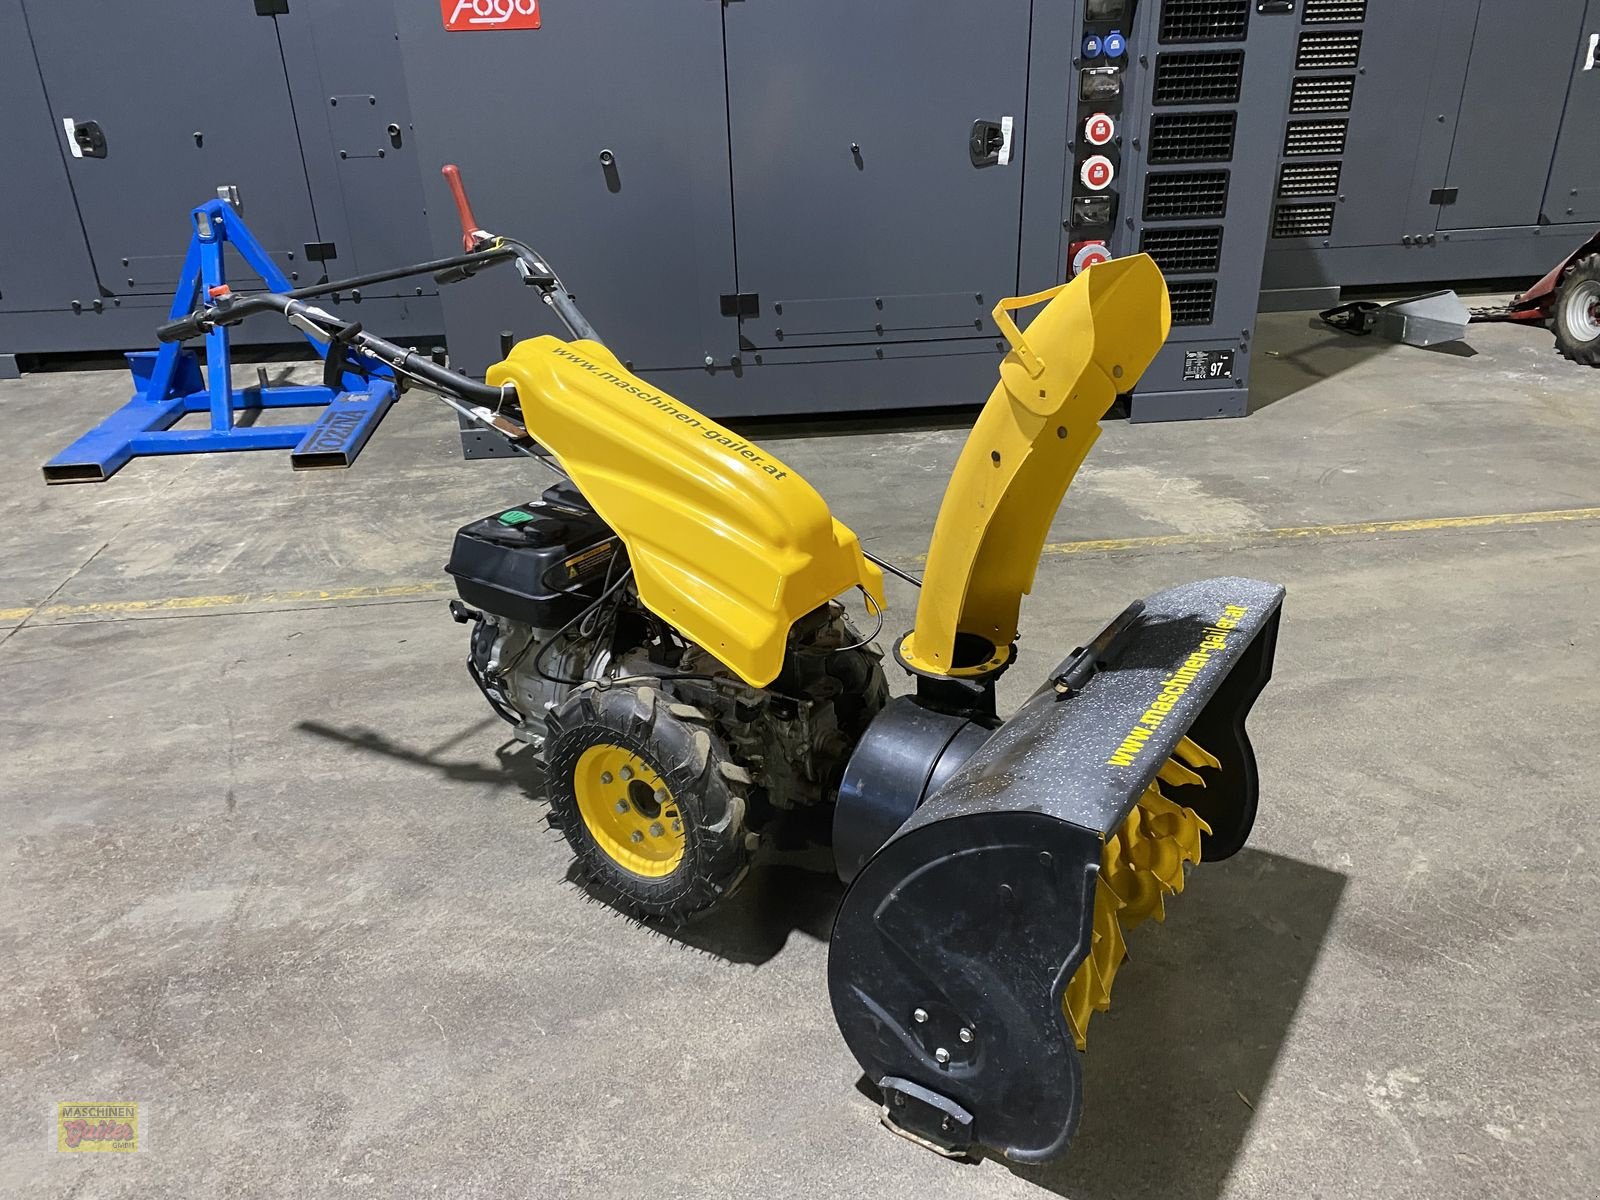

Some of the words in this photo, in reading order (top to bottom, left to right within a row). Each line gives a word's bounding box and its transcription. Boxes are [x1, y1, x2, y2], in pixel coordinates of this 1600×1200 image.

[552, 346, 788, 481] www.maschinen-gailer.at
[1210, 362, 1223, 376] 97
[1105, 604, 1248, 767] www.maschinen-gailer.at
